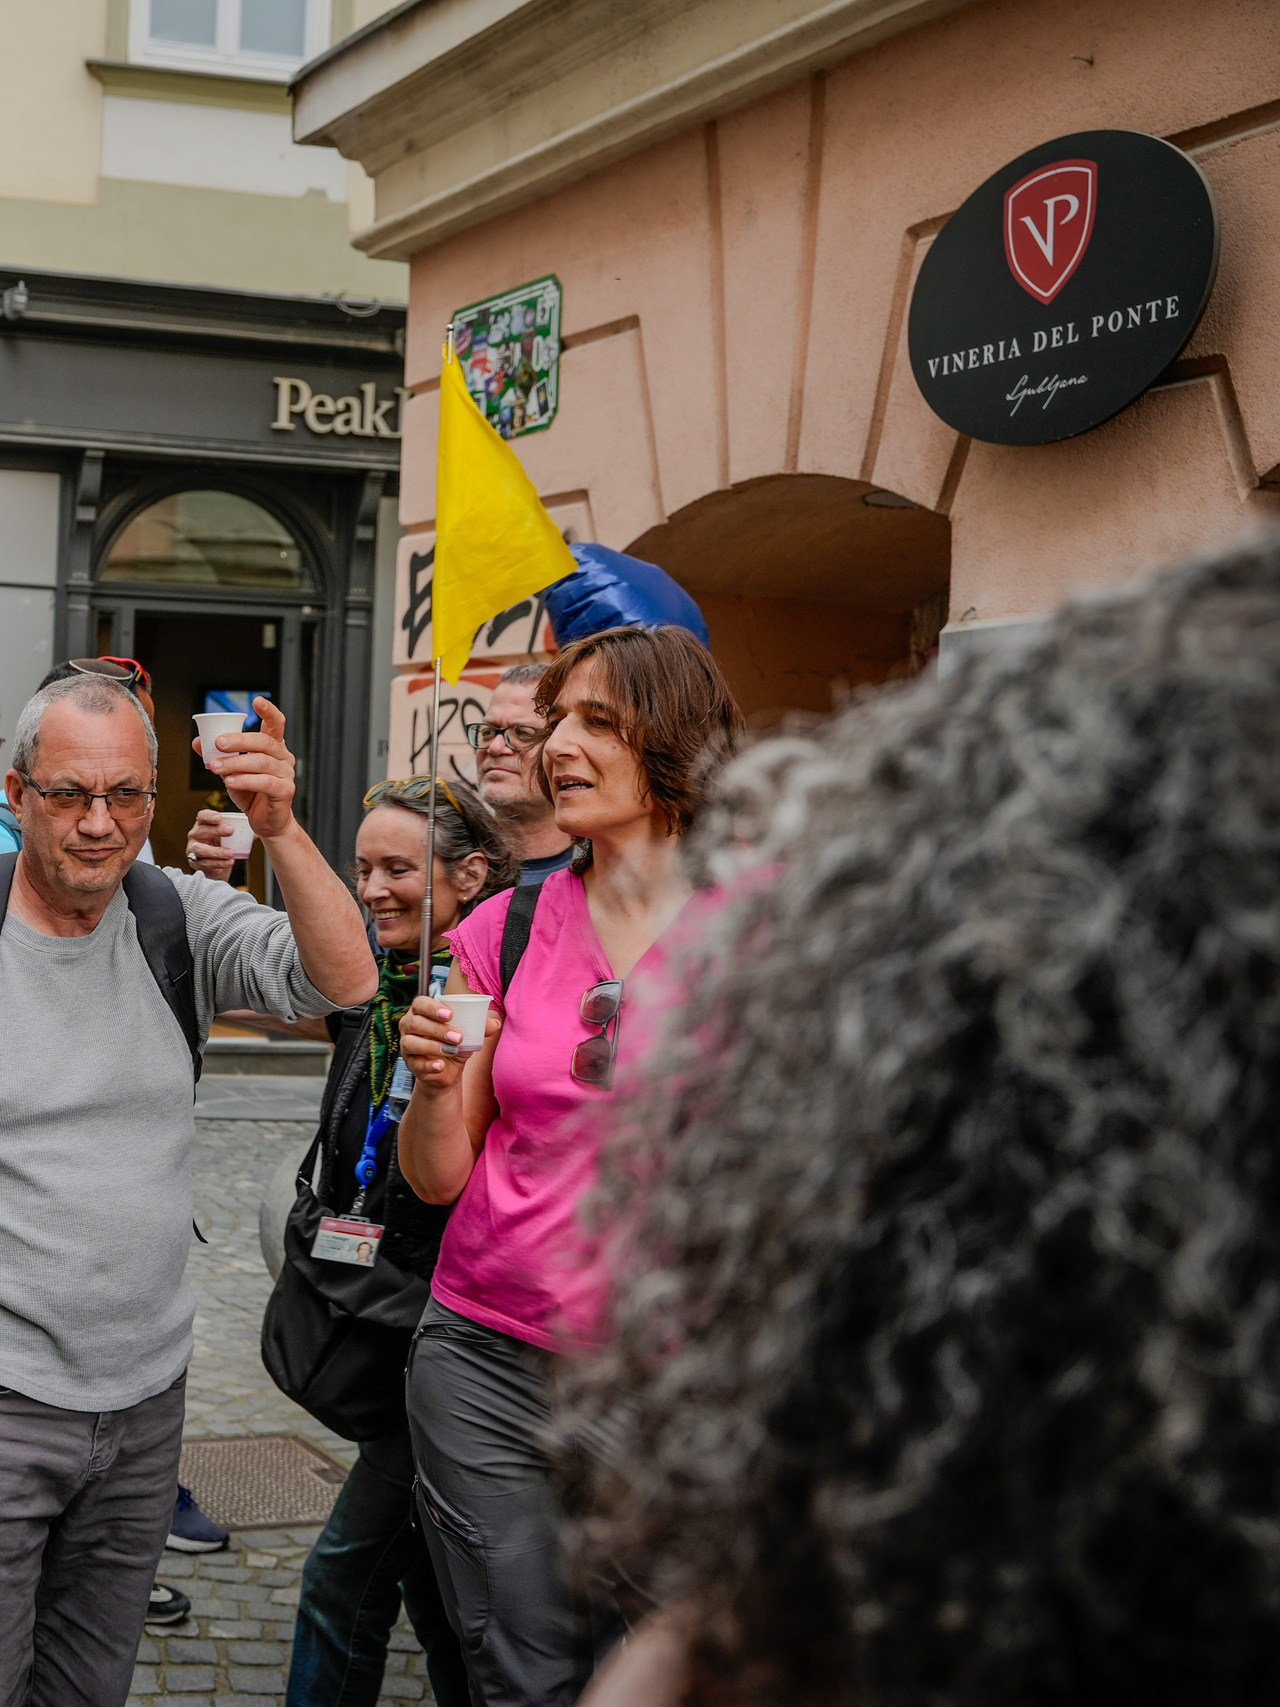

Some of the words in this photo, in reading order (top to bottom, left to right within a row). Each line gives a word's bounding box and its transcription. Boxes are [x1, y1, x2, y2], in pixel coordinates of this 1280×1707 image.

[1018, 193, 1080, 267] VP
[927, 337, 1022, 379] VINERIA
[1032, 322, 1080, 353] DEL
[1091, 295, 1180, 338] PONTE
[1005, 374, 1089, 418] Ljubljana
